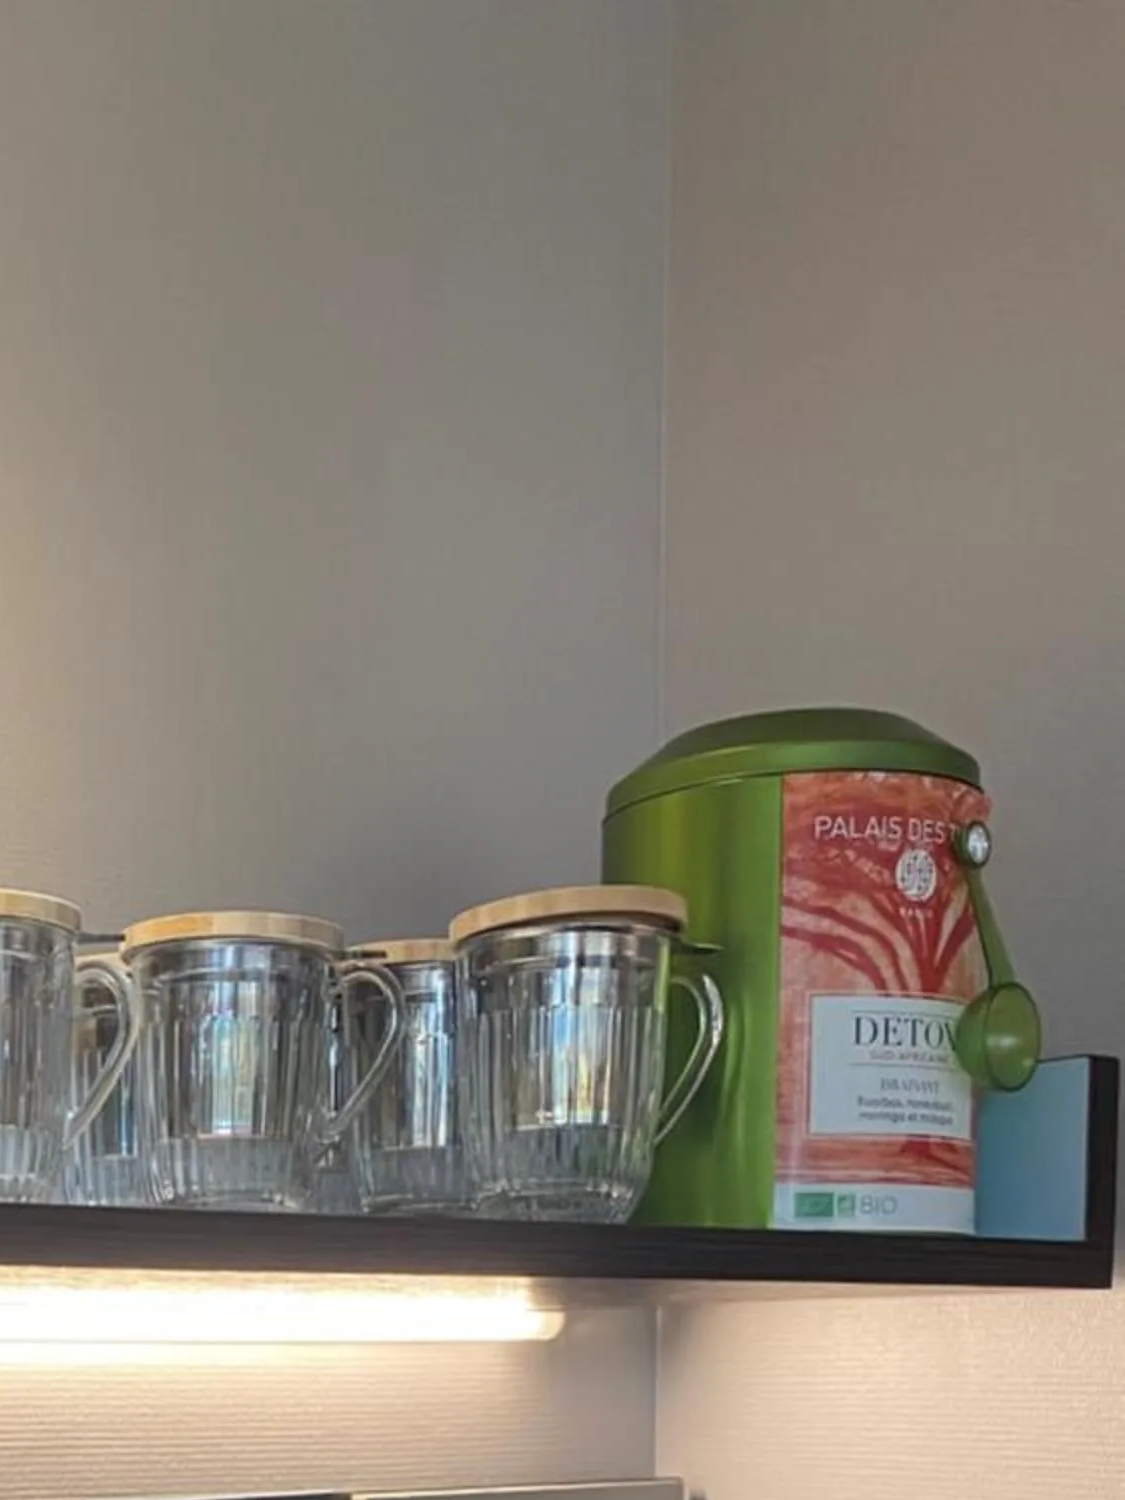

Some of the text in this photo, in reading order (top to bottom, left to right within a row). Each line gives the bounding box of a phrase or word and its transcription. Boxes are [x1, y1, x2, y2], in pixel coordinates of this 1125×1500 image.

[814, 814, 903, 841] PALAIS
[906, 817, 946, 845] DES
[858, 1194, 898, 1216] BIO
